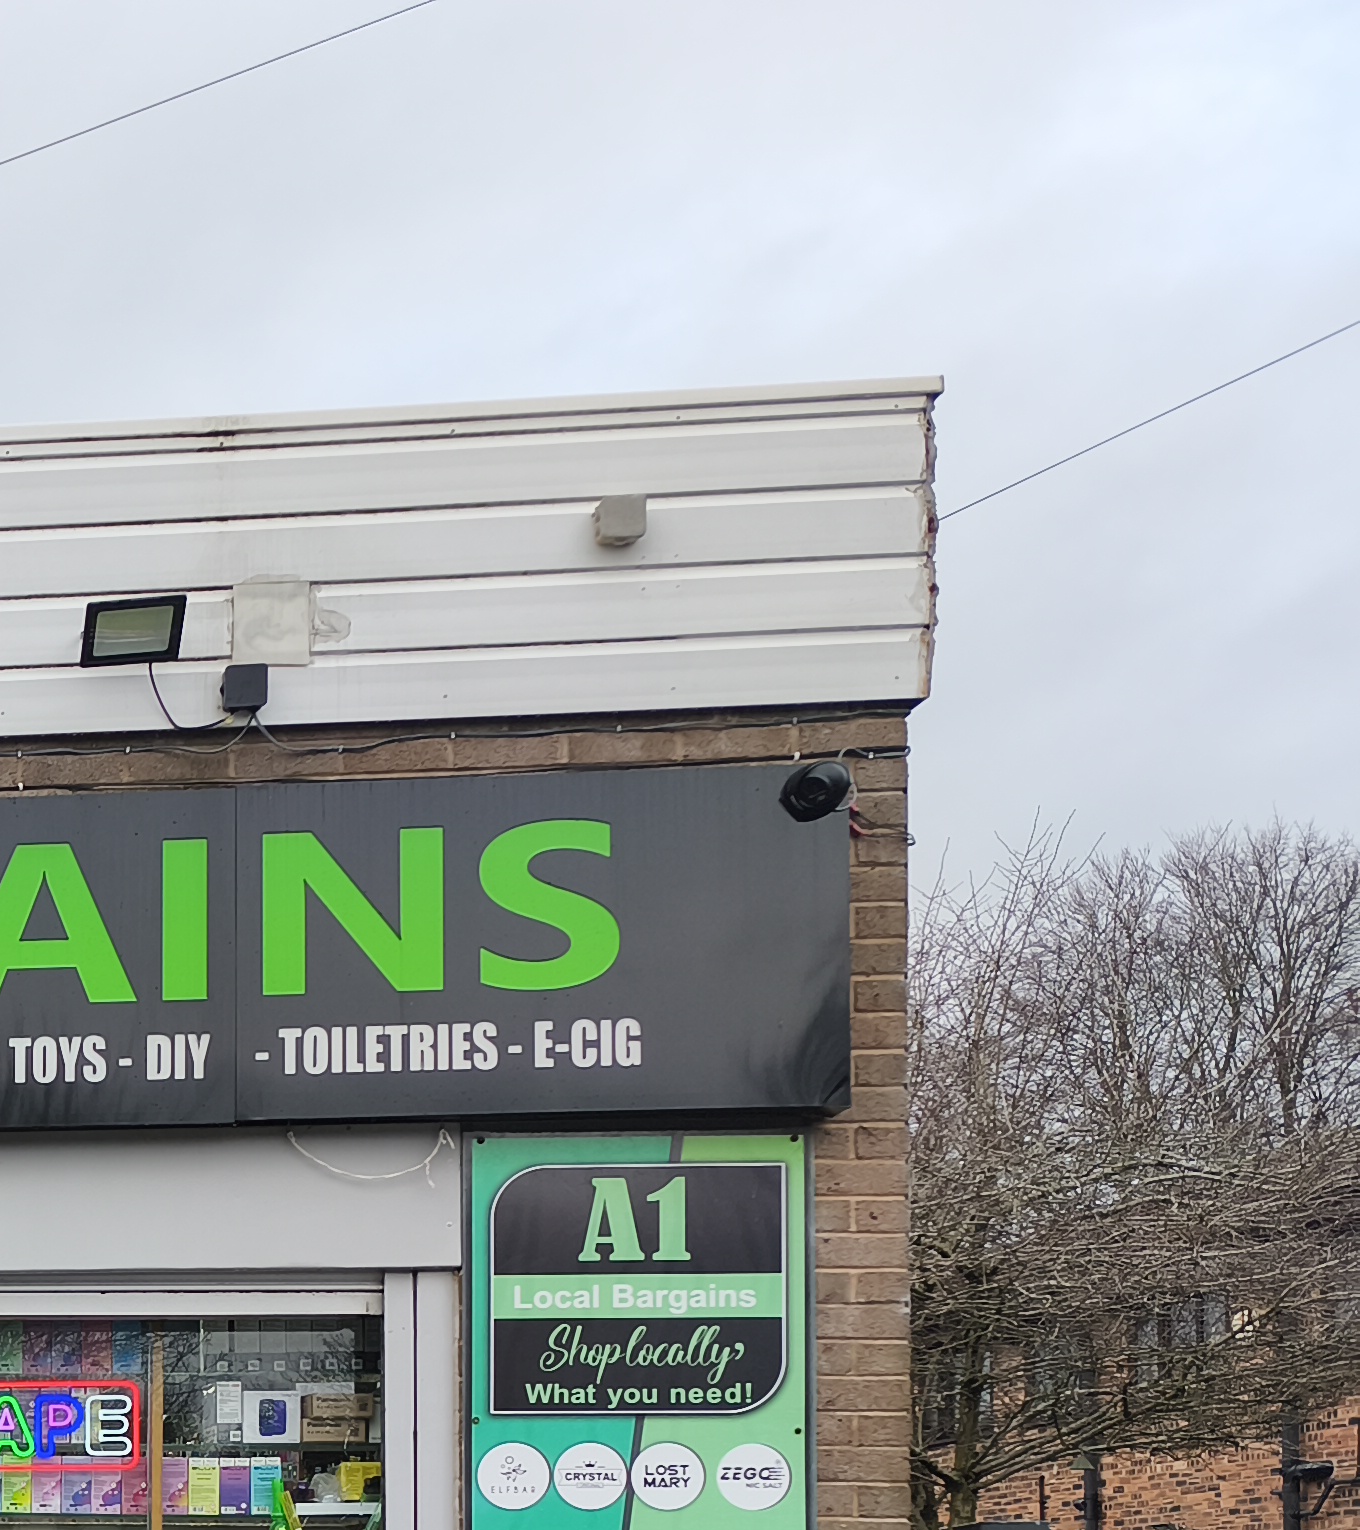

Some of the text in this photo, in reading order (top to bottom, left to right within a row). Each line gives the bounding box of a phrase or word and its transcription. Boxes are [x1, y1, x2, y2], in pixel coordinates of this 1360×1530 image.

[8, 1035, 107, 1084] TOYS
[145, 1033, 211, 1081] DIY
[278, 1021, 498, 1075] TOILETRIES
[534, 1018, 642, 1069] E-CIG
[578, 1176, 691, 1261] A1
[513, 1284, 757, 1314] Local Bargains
[525, 1383, 753, 1409] What you need!
[564, 1472, 618, 1482] CRYSTAL
[643, 1476, 691, 1488] MARY
[644, 1464, 690, 1475] LOST
